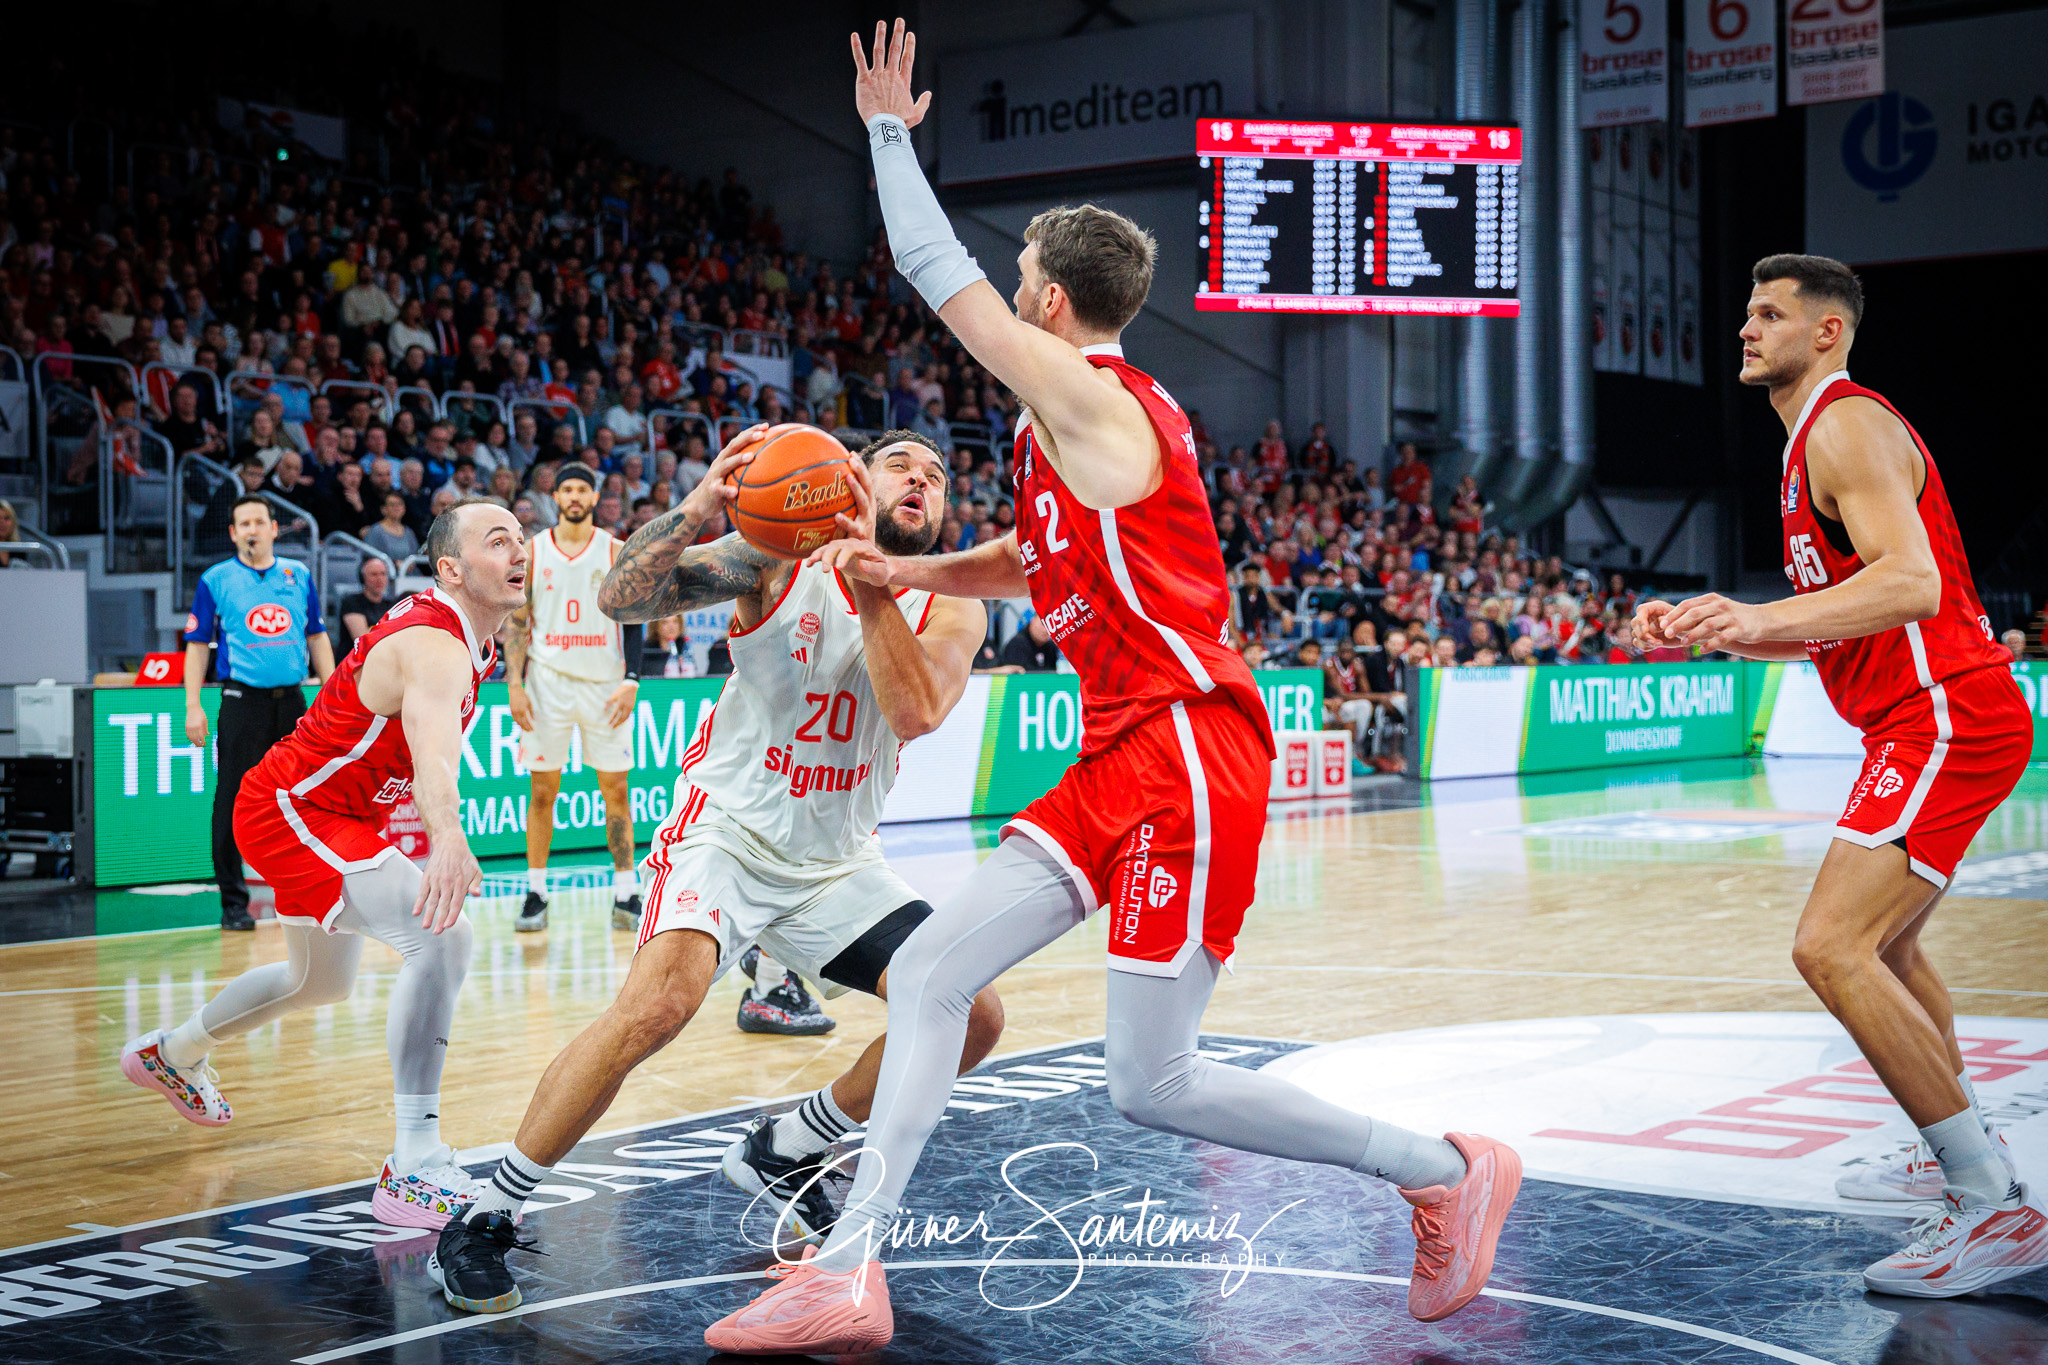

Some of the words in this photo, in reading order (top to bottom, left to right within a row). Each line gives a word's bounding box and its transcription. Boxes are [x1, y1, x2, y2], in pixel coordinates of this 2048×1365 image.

[1789, 20, 1879, 49] brose
[1581, 48, 1664, 75] brose
[1687, 43, 1773, 72] brose
[1790, 43, 1879, 68] baskets
[1583, 69, 1664, 93] baskets
[1687, 67, 1773, 89] bamberg
[1211, 122, 1234, 141] 15
[1488, 130, 1510, 149] 15
[1035, 491, 1069, 554] 2
[1789, 533, 1828, 588] 65
[567, 599, 579, 623] 0
[1550, 675, 1655, 725] MATTHIAS
[1660, 673, 1734, 718] KRAHM
[795, 690, 858, 743] 20
[552, 786, 667, 830] COBRG
[1123, 824, 1154, 944] DATOLUTION
